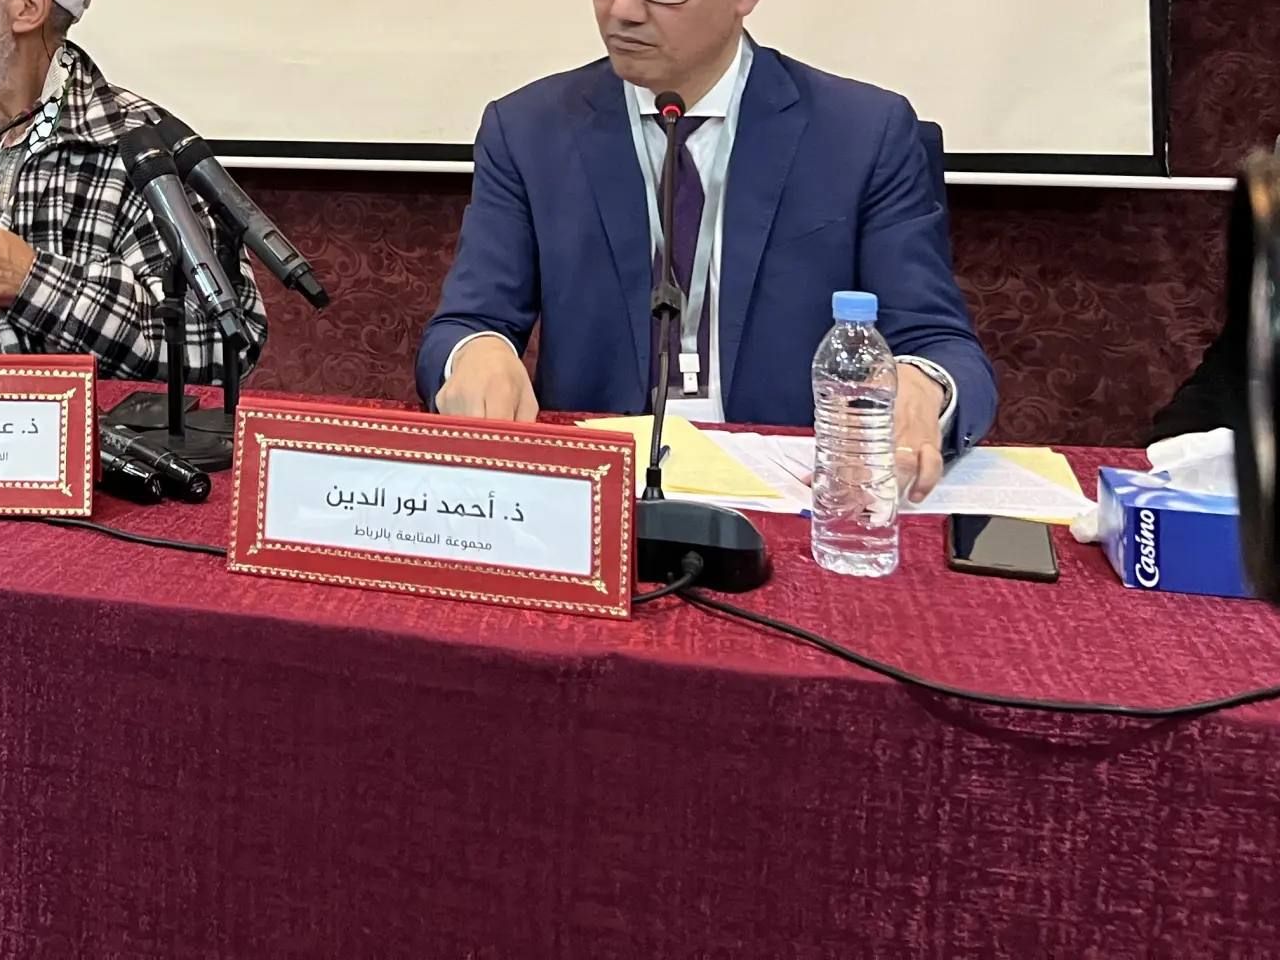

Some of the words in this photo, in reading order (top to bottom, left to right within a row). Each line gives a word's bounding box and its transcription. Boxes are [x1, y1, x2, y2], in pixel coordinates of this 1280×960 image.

[326, 485, 385, 510] الدين
[393, 493, 427, 516] نور
[437, 490, 495, 519] أحمد
[354, 525, 391, 541] بالرباط
[396, 531, 440, 545] المتابعة
[446, 536, 492, 550] مجموعة
[1135, 509, 1159, 588] Casino
